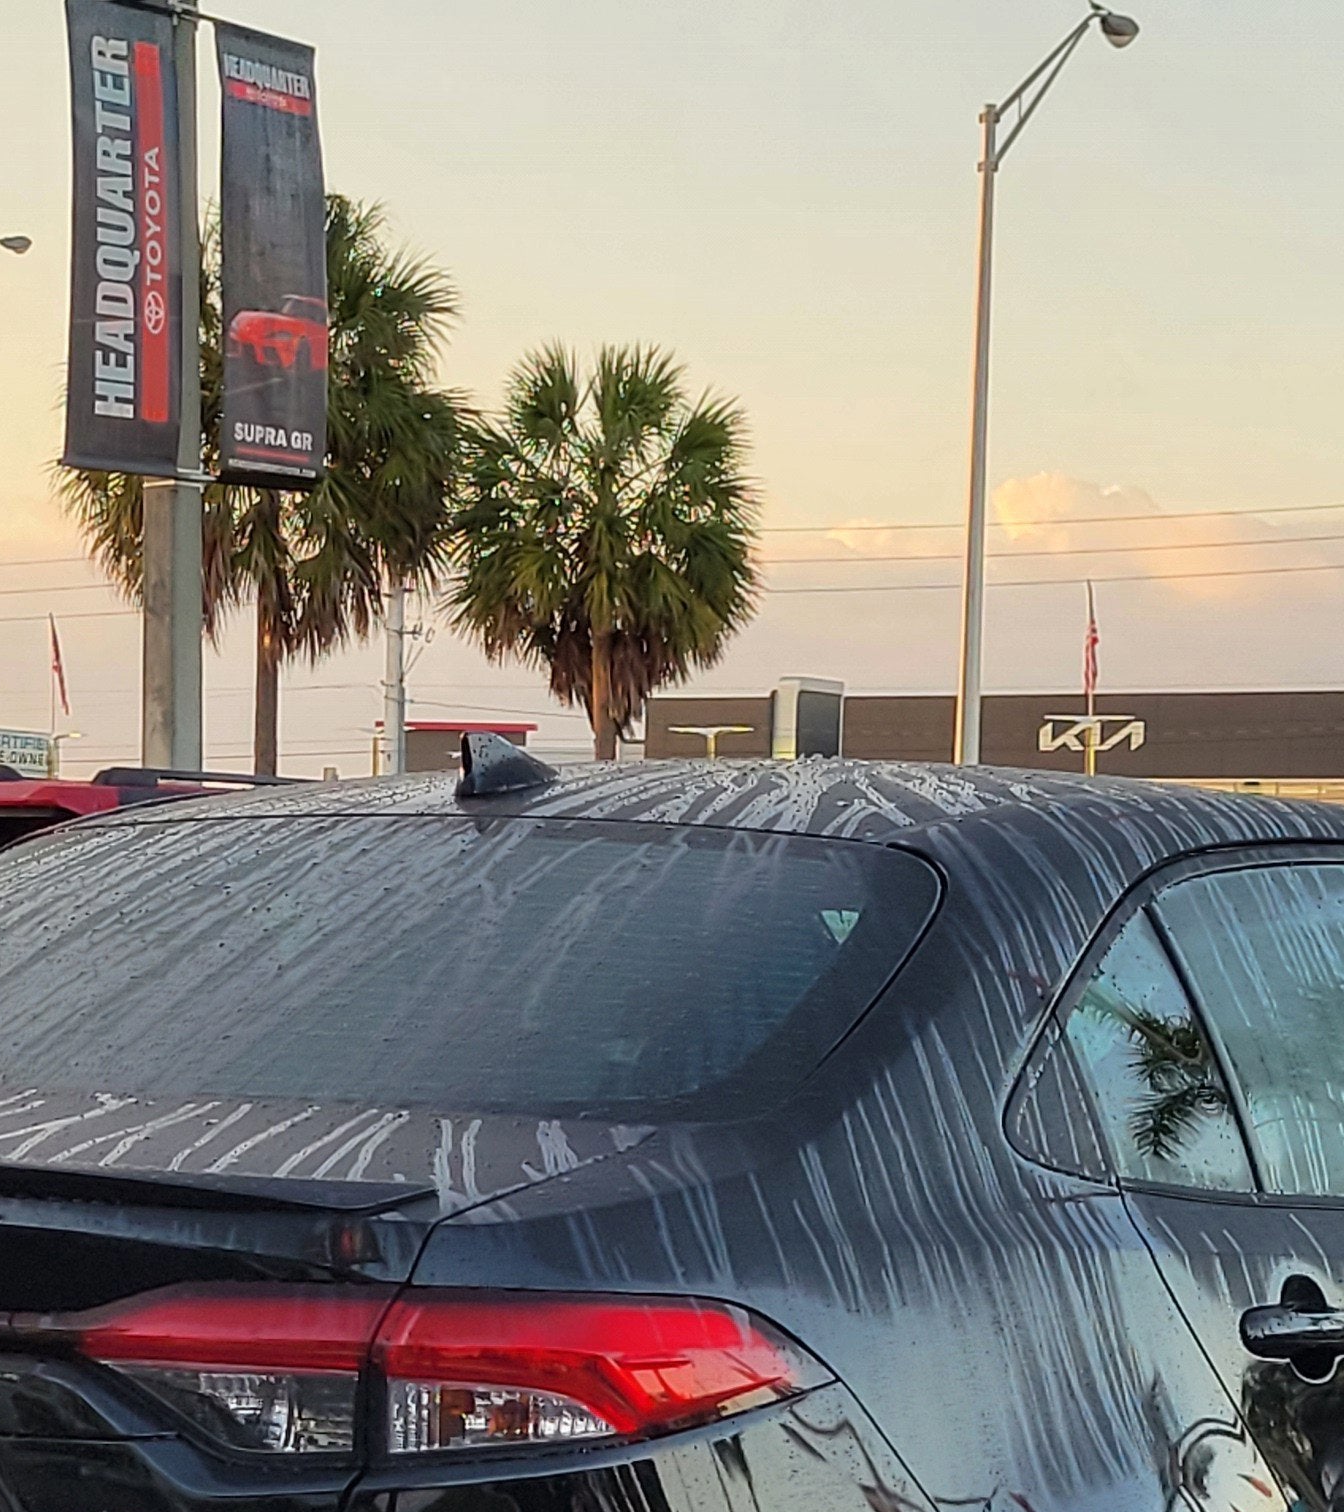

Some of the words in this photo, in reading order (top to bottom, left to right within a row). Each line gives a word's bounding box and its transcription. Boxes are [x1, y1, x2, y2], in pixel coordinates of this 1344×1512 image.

[90, 35, 140, 420] HEADQUARTER
[144, 146, 162, 286] TOYOTA
[233, 421, 288, 448] SUPRA
[291, 430, 313, 452] GR
[1038, 720, 1146, 751] KIA
